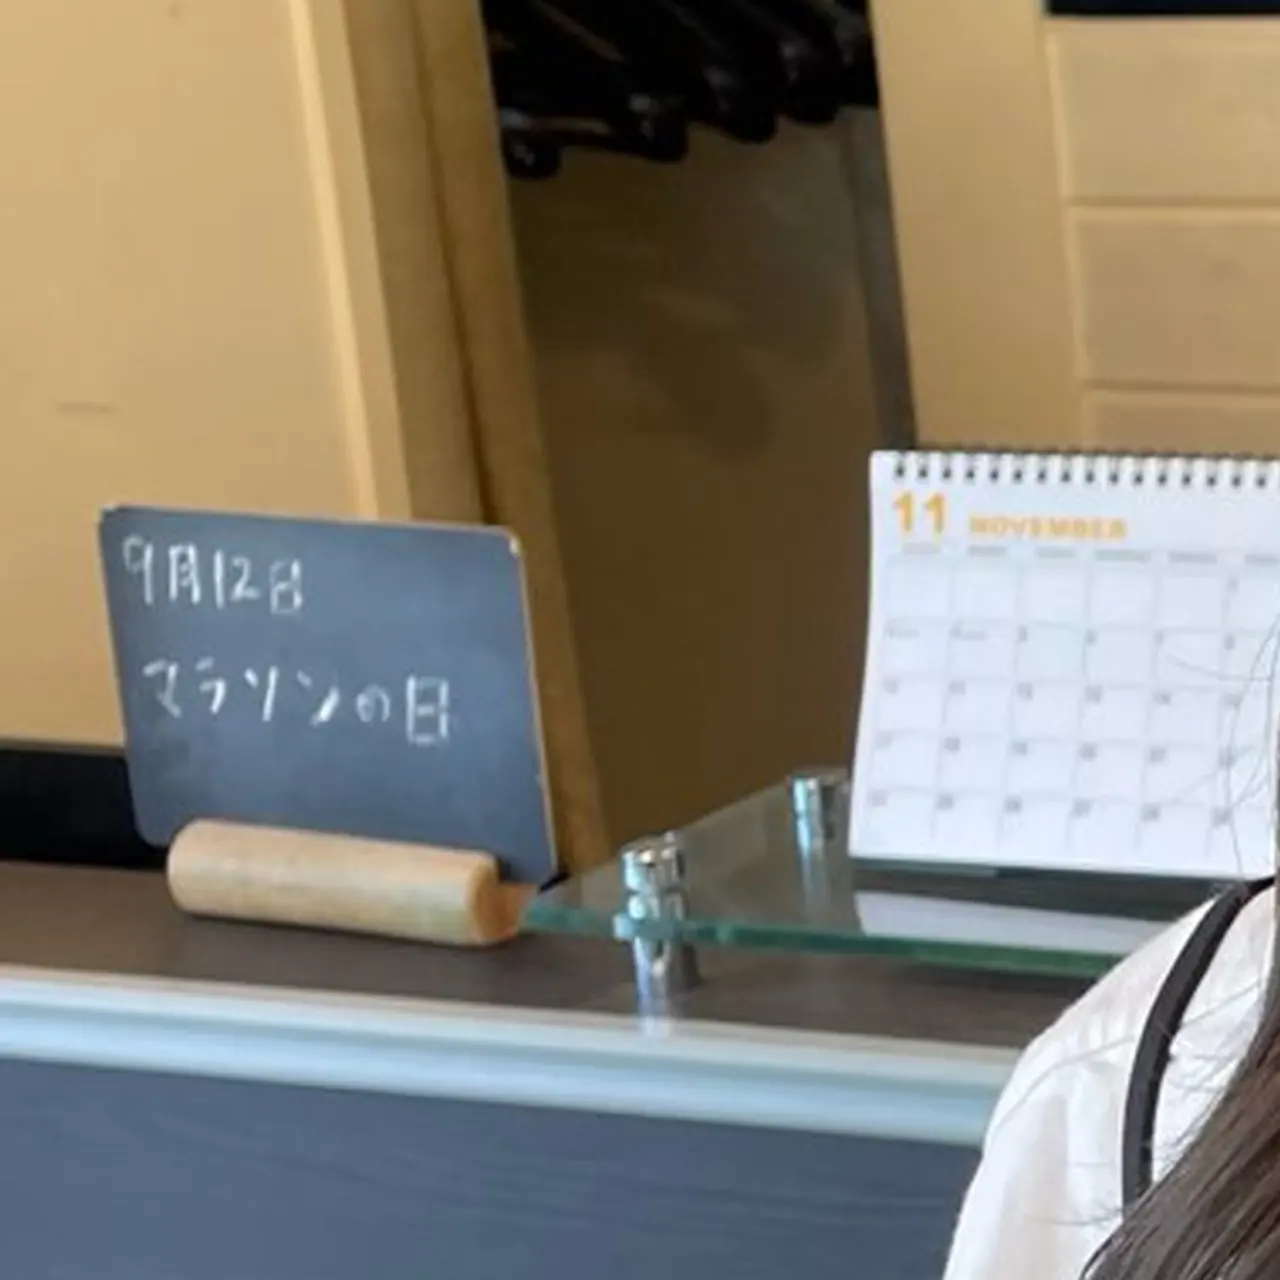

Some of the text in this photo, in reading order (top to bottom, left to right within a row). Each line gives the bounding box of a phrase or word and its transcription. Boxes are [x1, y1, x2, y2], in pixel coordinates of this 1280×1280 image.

[892, 491, 1128, 540] 11 NOVEMBER
[122, 535, 304, 616] 9月12日
[143, 656, 449, 746] マラソンの日
